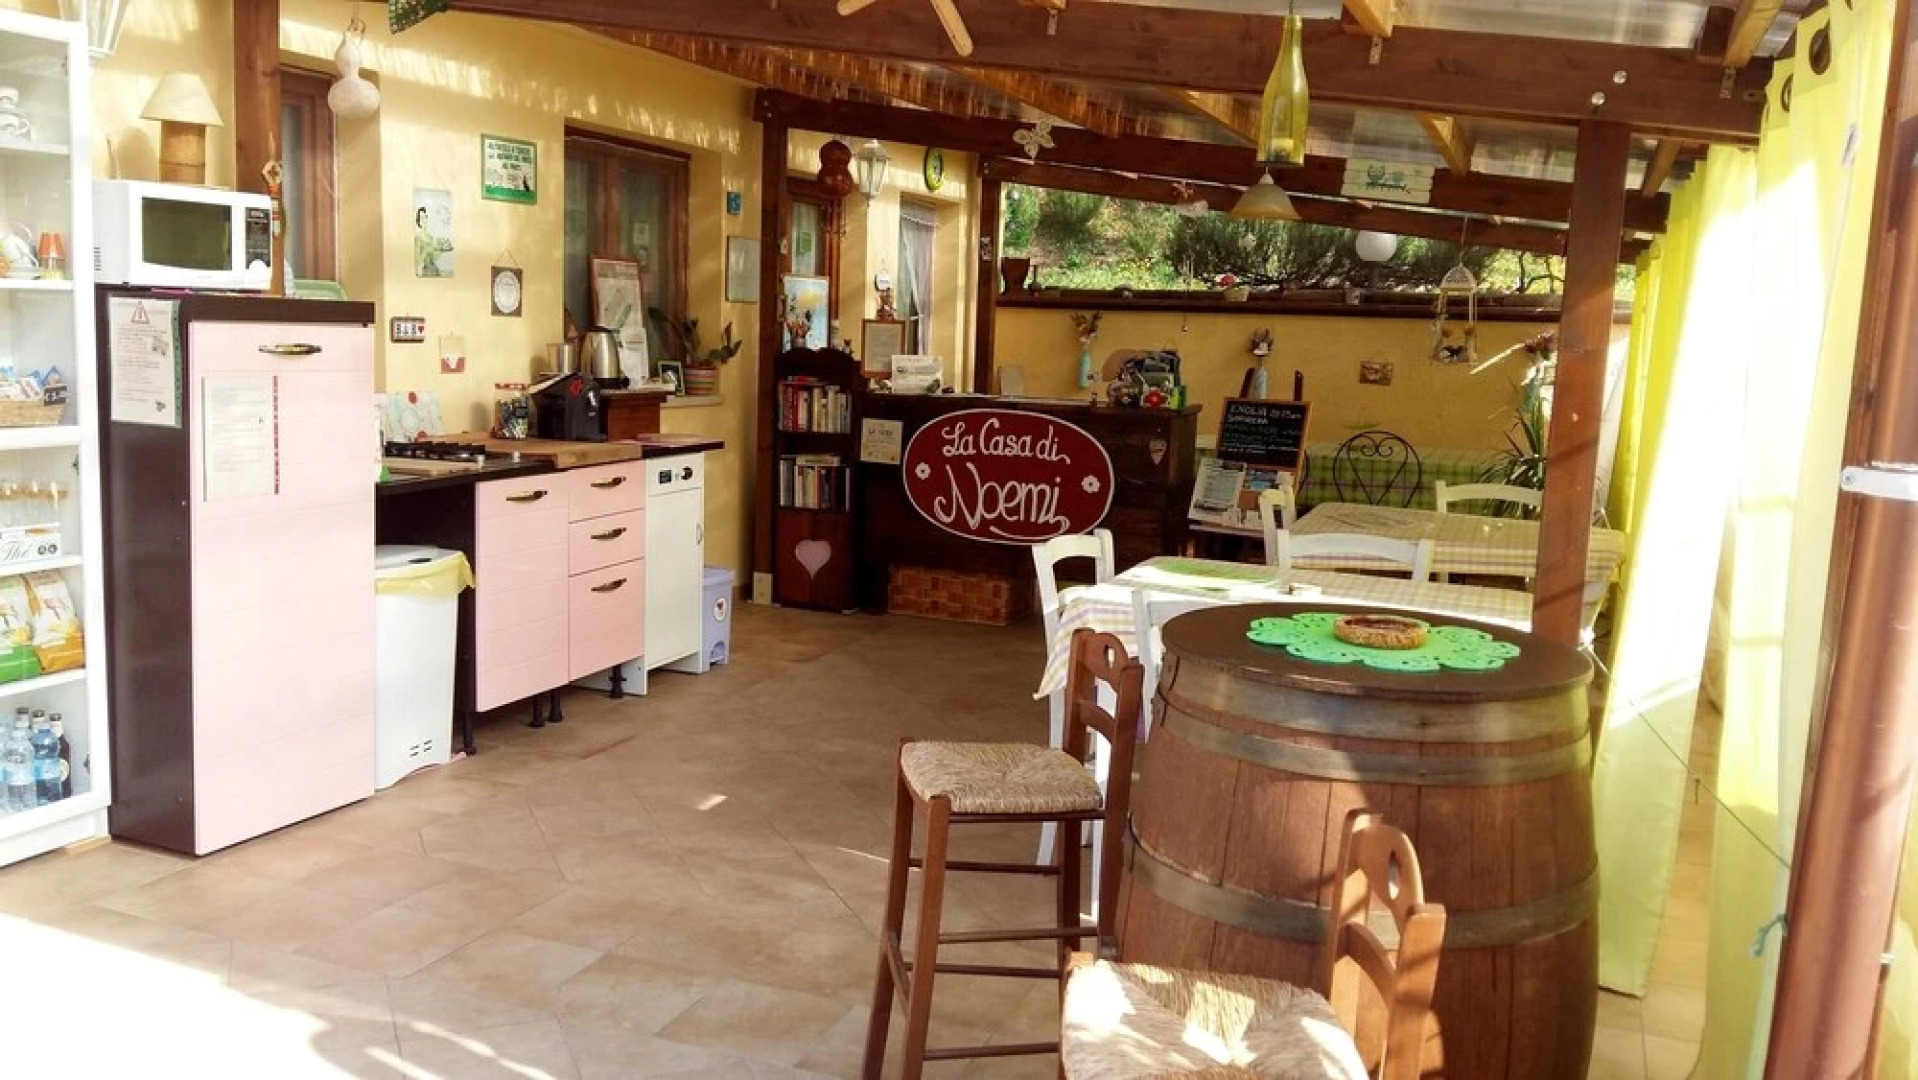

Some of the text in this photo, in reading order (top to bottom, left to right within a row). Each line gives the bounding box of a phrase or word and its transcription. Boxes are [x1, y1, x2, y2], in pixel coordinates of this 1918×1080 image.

[941, 417, 1071, 464] La Casa di
[933, 462, 1071, 539] Noemi
